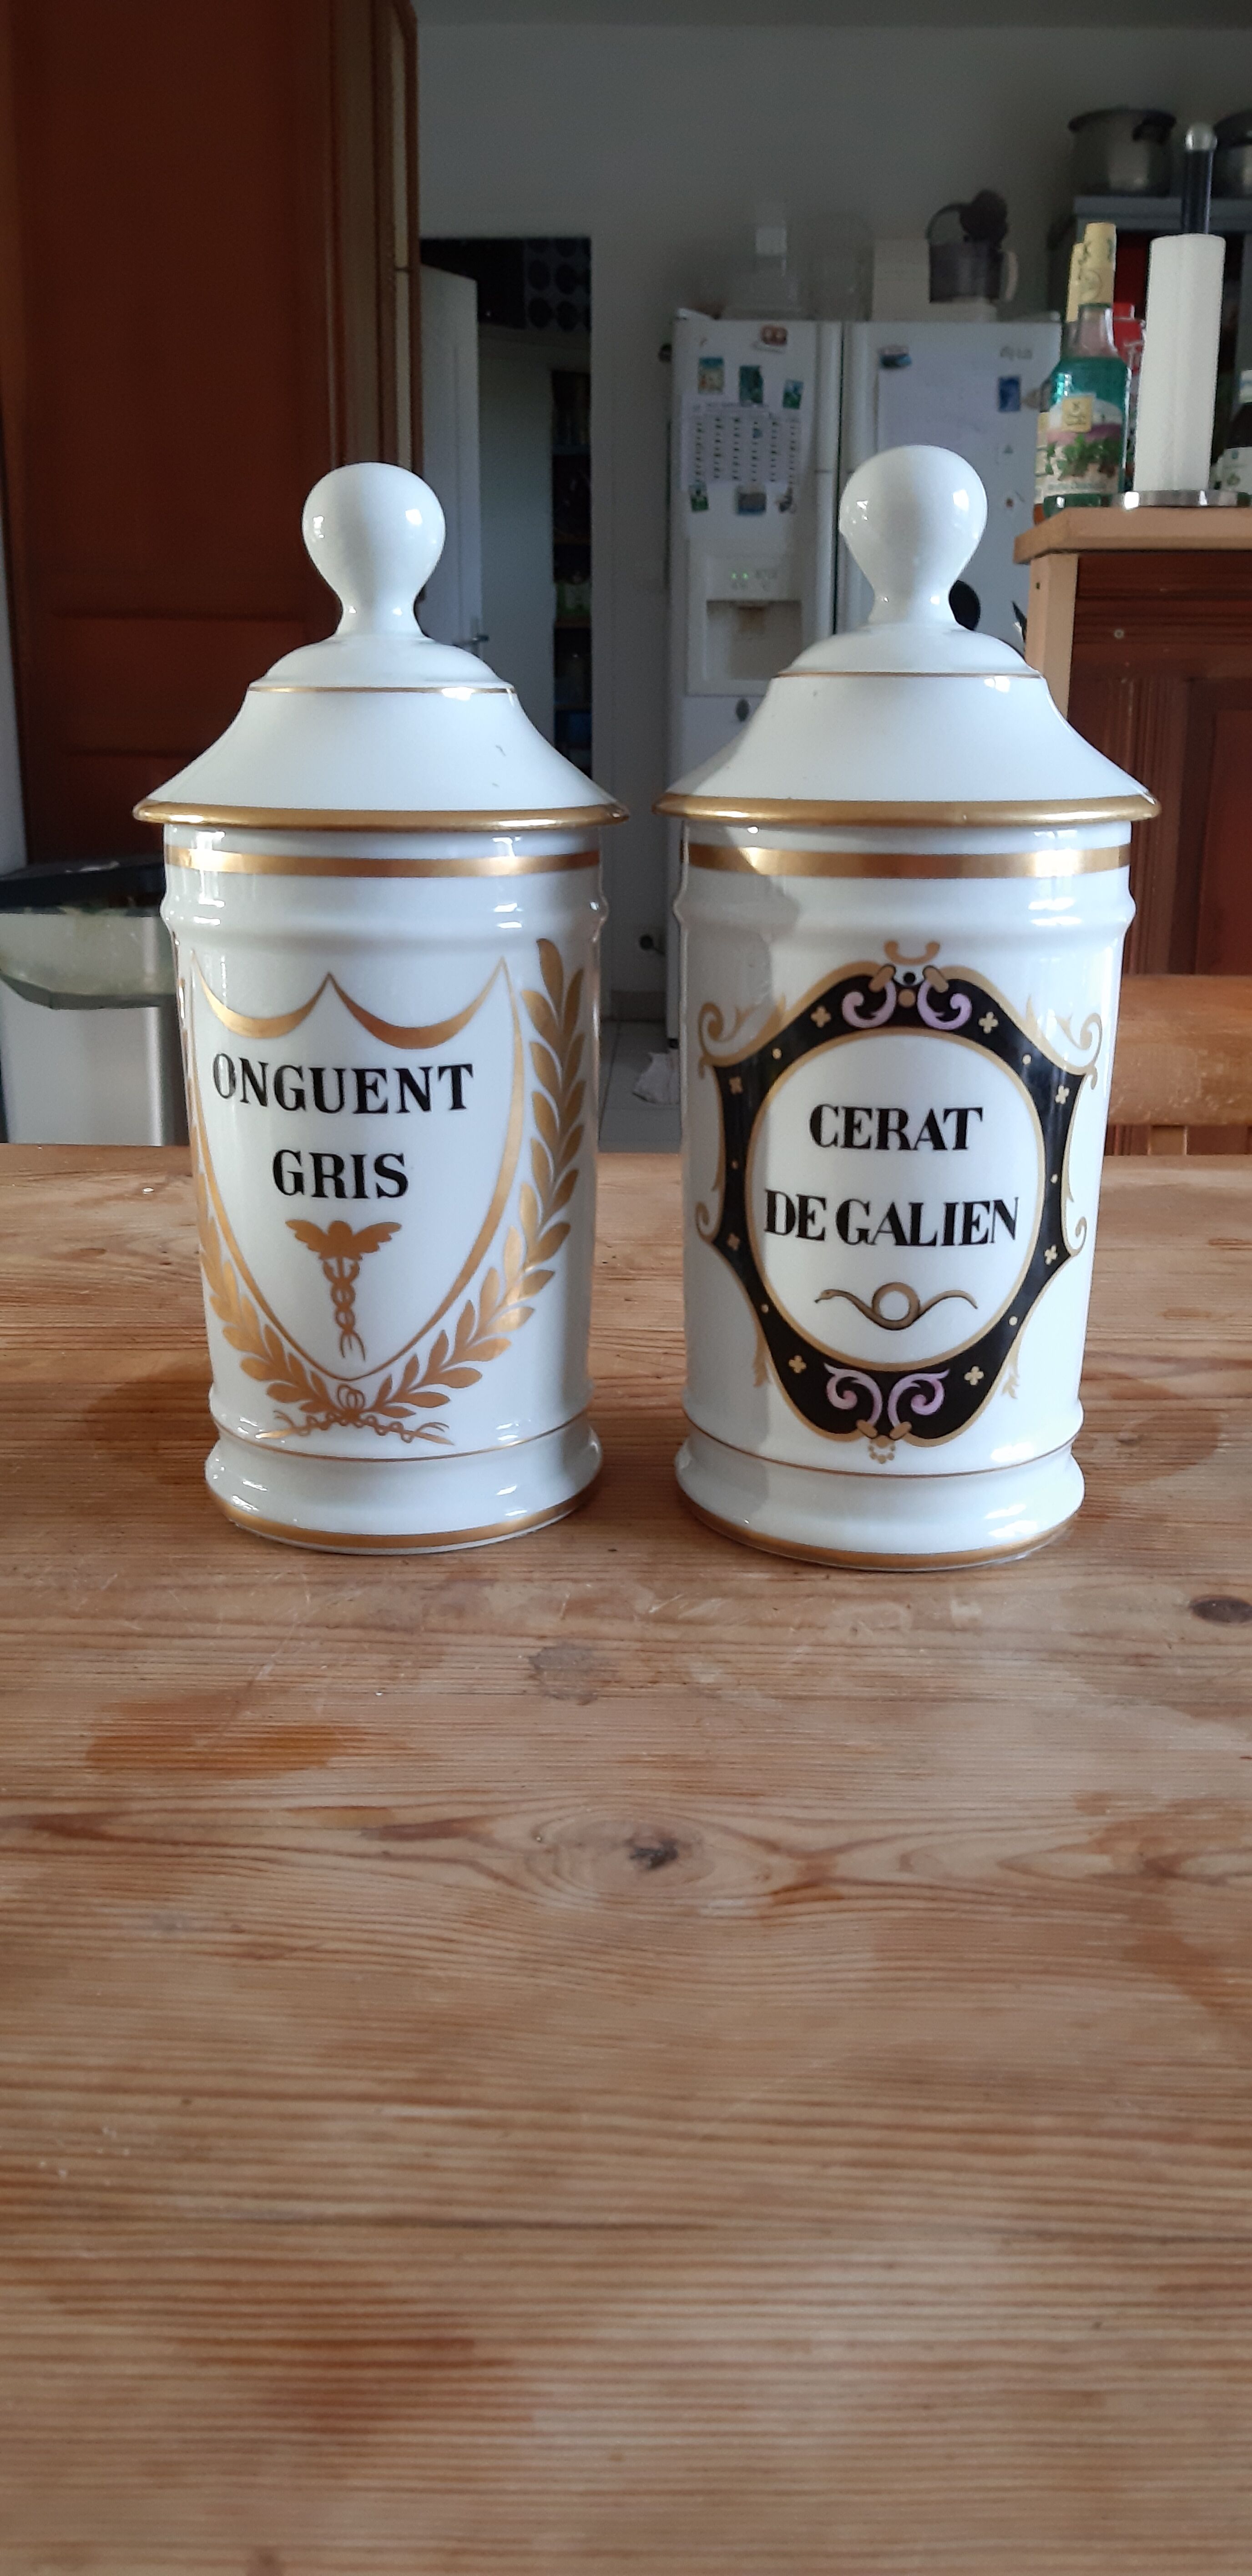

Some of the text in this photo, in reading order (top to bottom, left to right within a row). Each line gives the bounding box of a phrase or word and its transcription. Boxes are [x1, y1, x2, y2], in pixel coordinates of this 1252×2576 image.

[212, 1053, 474, 1114] ONGUENT
[810, 1104, 983, 1151] CERAT
[273, 1149, 409, 1199] GRIS
[765, 1189, 1019, 1247] DE GALIEN
